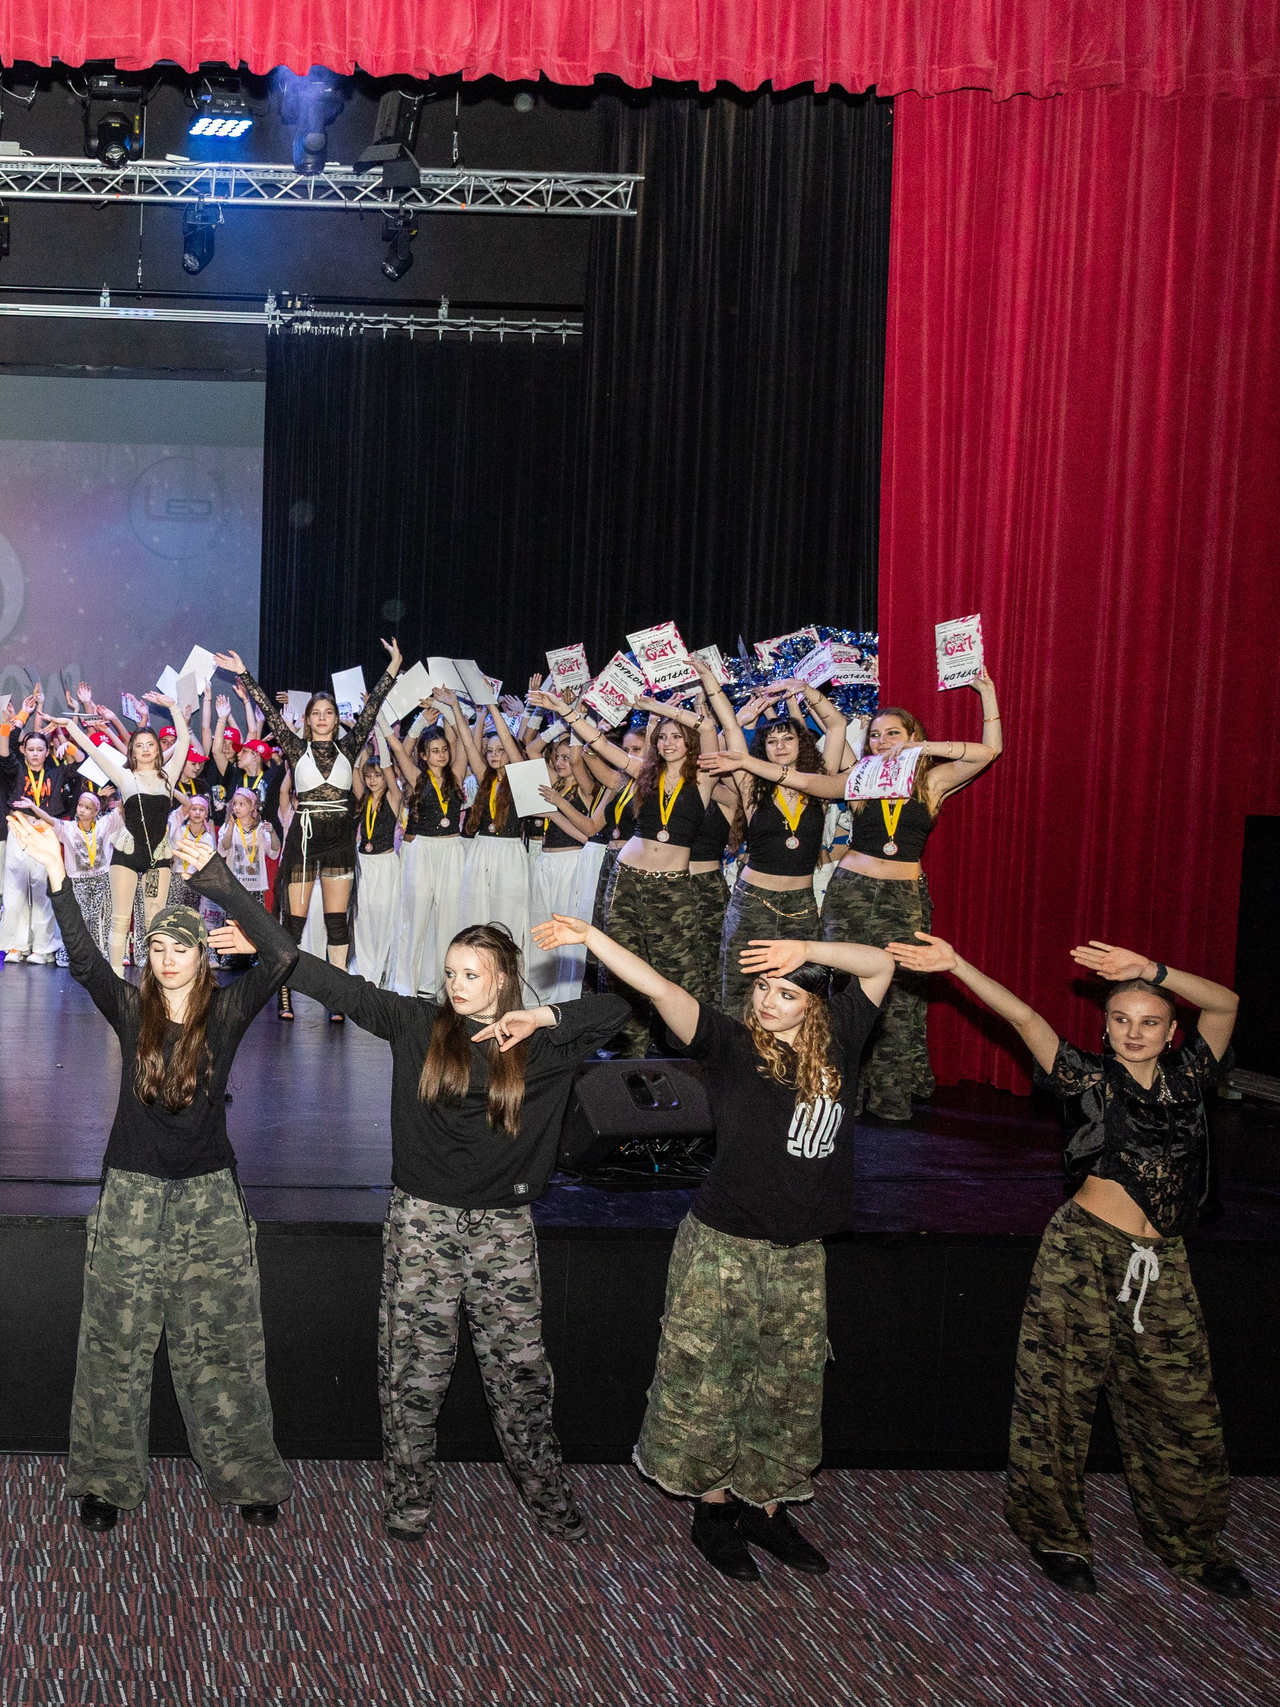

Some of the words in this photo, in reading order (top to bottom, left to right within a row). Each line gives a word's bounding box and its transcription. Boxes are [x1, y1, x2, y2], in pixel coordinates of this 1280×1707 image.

[645, 640, 676, 661] LEO
[945, 634, 973, 656] LEO
[614, 662, 645, 687] DYPLOM
[654, 668, 690, 684] DYPLOM
[943, 667, 979, 682] DYPLOM
[599, 681, 626, 706] LEO
[853, 758, 872, 793] DYPLOM
